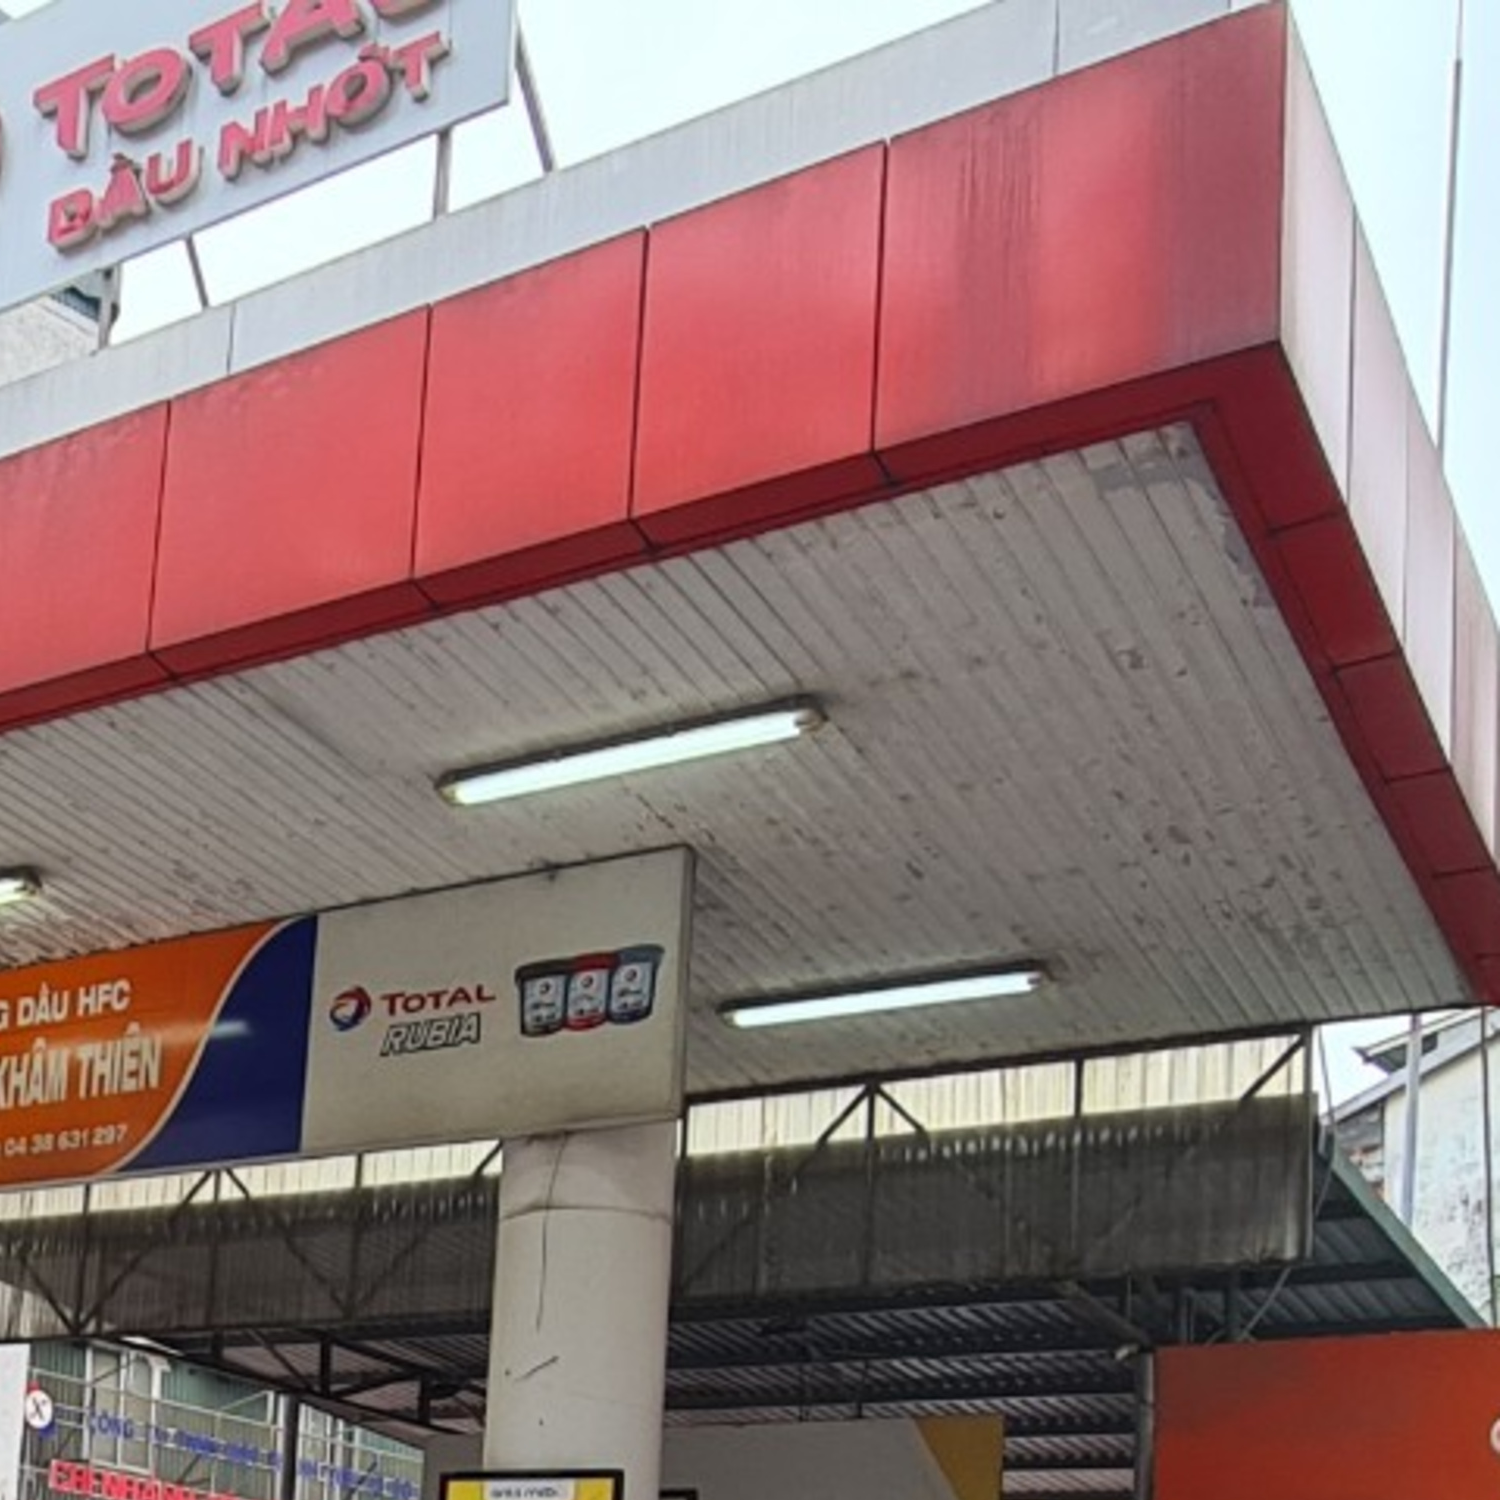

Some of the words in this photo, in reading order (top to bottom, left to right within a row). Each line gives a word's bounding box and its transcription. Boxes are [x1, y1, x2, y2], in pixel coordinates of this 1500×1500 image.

[33, 0, 437, 160] TOTA
[77, 977, 132, 1018] HFC
[379, 982, 498, 1018] TOTAL
[379, 1011, 483, 1057] RUBIA
[76, 1020, 164, 1100] THIÊN
